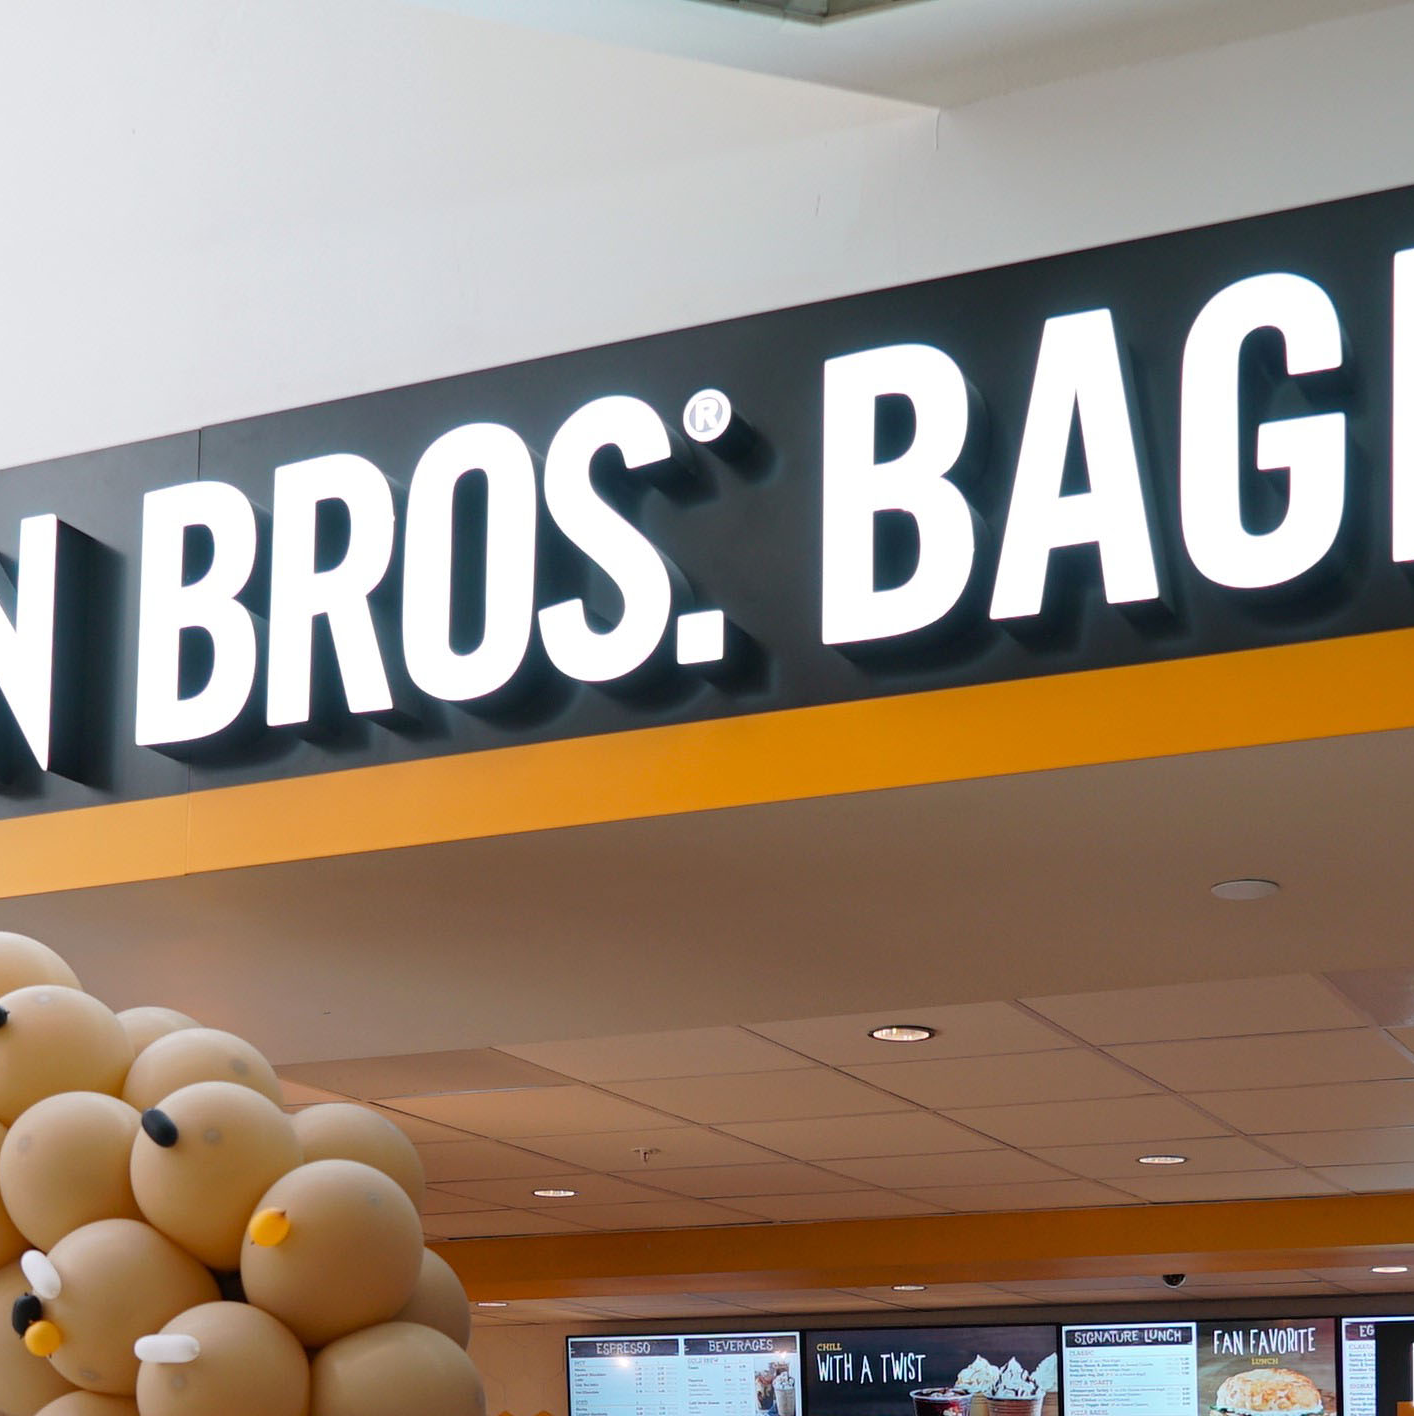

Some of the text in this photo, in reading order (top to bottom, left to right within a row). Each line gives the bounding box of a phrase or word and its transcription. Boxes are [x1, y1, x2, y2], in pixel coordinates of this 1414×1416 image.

[135, 395, 725, 746] BROS.
[1074, 1328, 1182, 1345] SIGNATURE LUNCH
[1213, 1327, 1316, 1355] FAN FAVORITE
[596, 1342, 650, 1355] ESPRESSO
[708, 1338, 774, 1353] BEVERAGES
[816, 1343, 842, 1351] CHILL
[816, 1352, 926, 1384] WITH A TWIST
